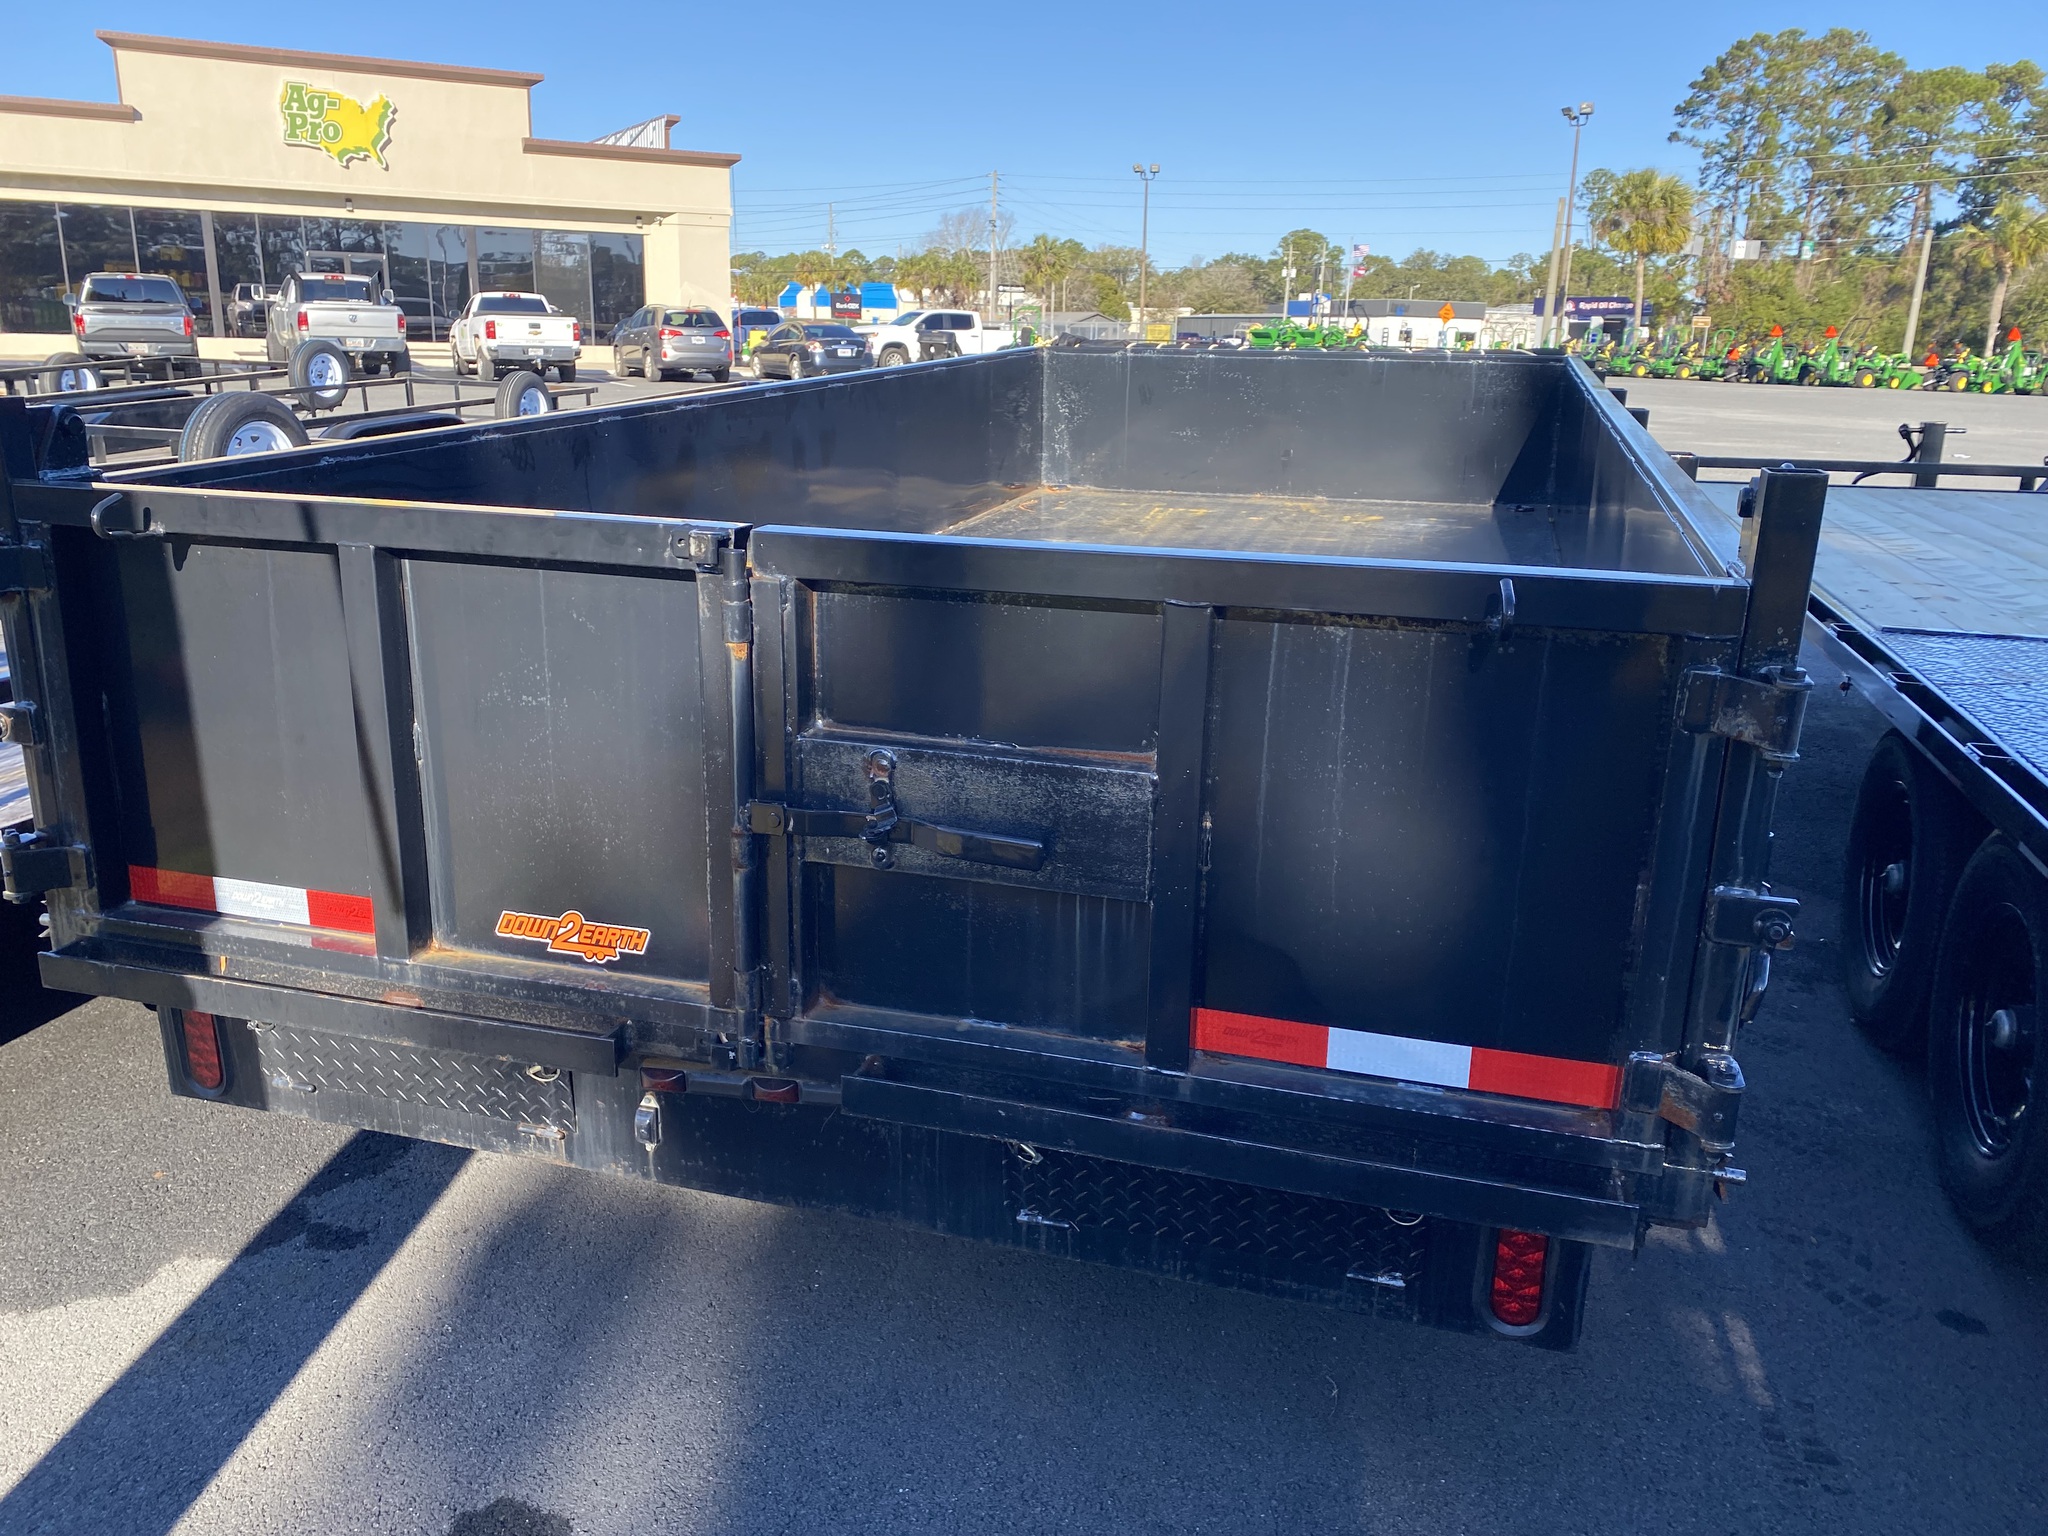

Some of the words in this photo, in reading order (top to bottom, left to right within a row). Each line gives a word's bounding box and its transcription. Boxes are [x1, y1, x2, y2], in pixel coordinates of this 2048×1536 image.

[283, 83, 339, 120] Ag-
[286, 111, 341, 142] Pro
[1578, 301, 1598, 310] Rapid
[1599, 301, 1608, 309] Oil
[1609, 301, 1634, 310] Change
